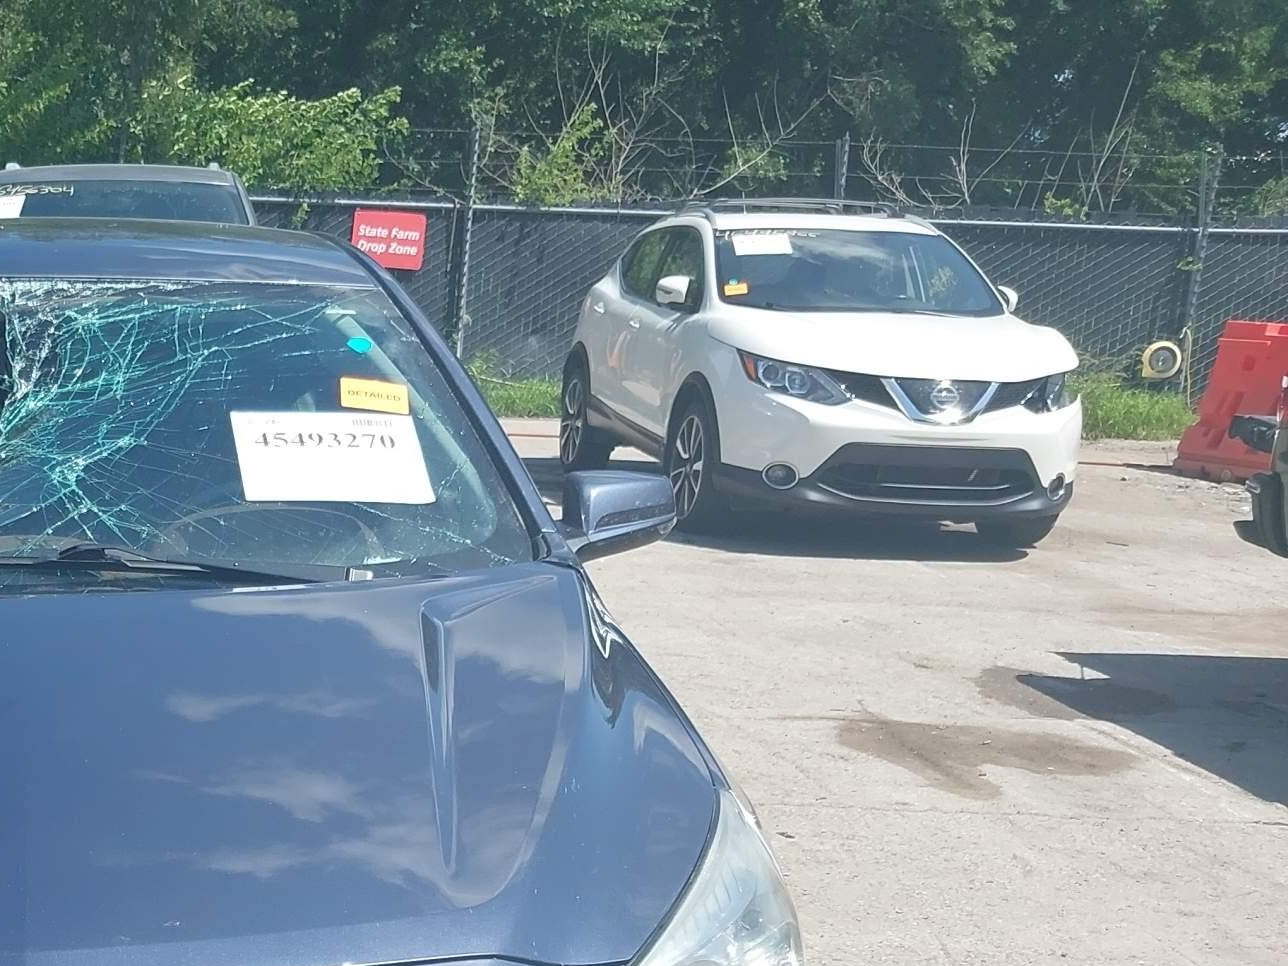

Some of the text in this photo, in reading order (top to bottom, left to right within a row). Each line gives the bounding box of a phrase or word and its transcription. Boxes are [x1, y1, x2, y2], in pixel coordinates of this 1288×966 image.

[357, 224, 420, 241] State Farm
[357, 239, 418, 256] Drop Zone
[347, 389, 401, 402] DETAILED
[254, 432, 396, 449] 45493270
